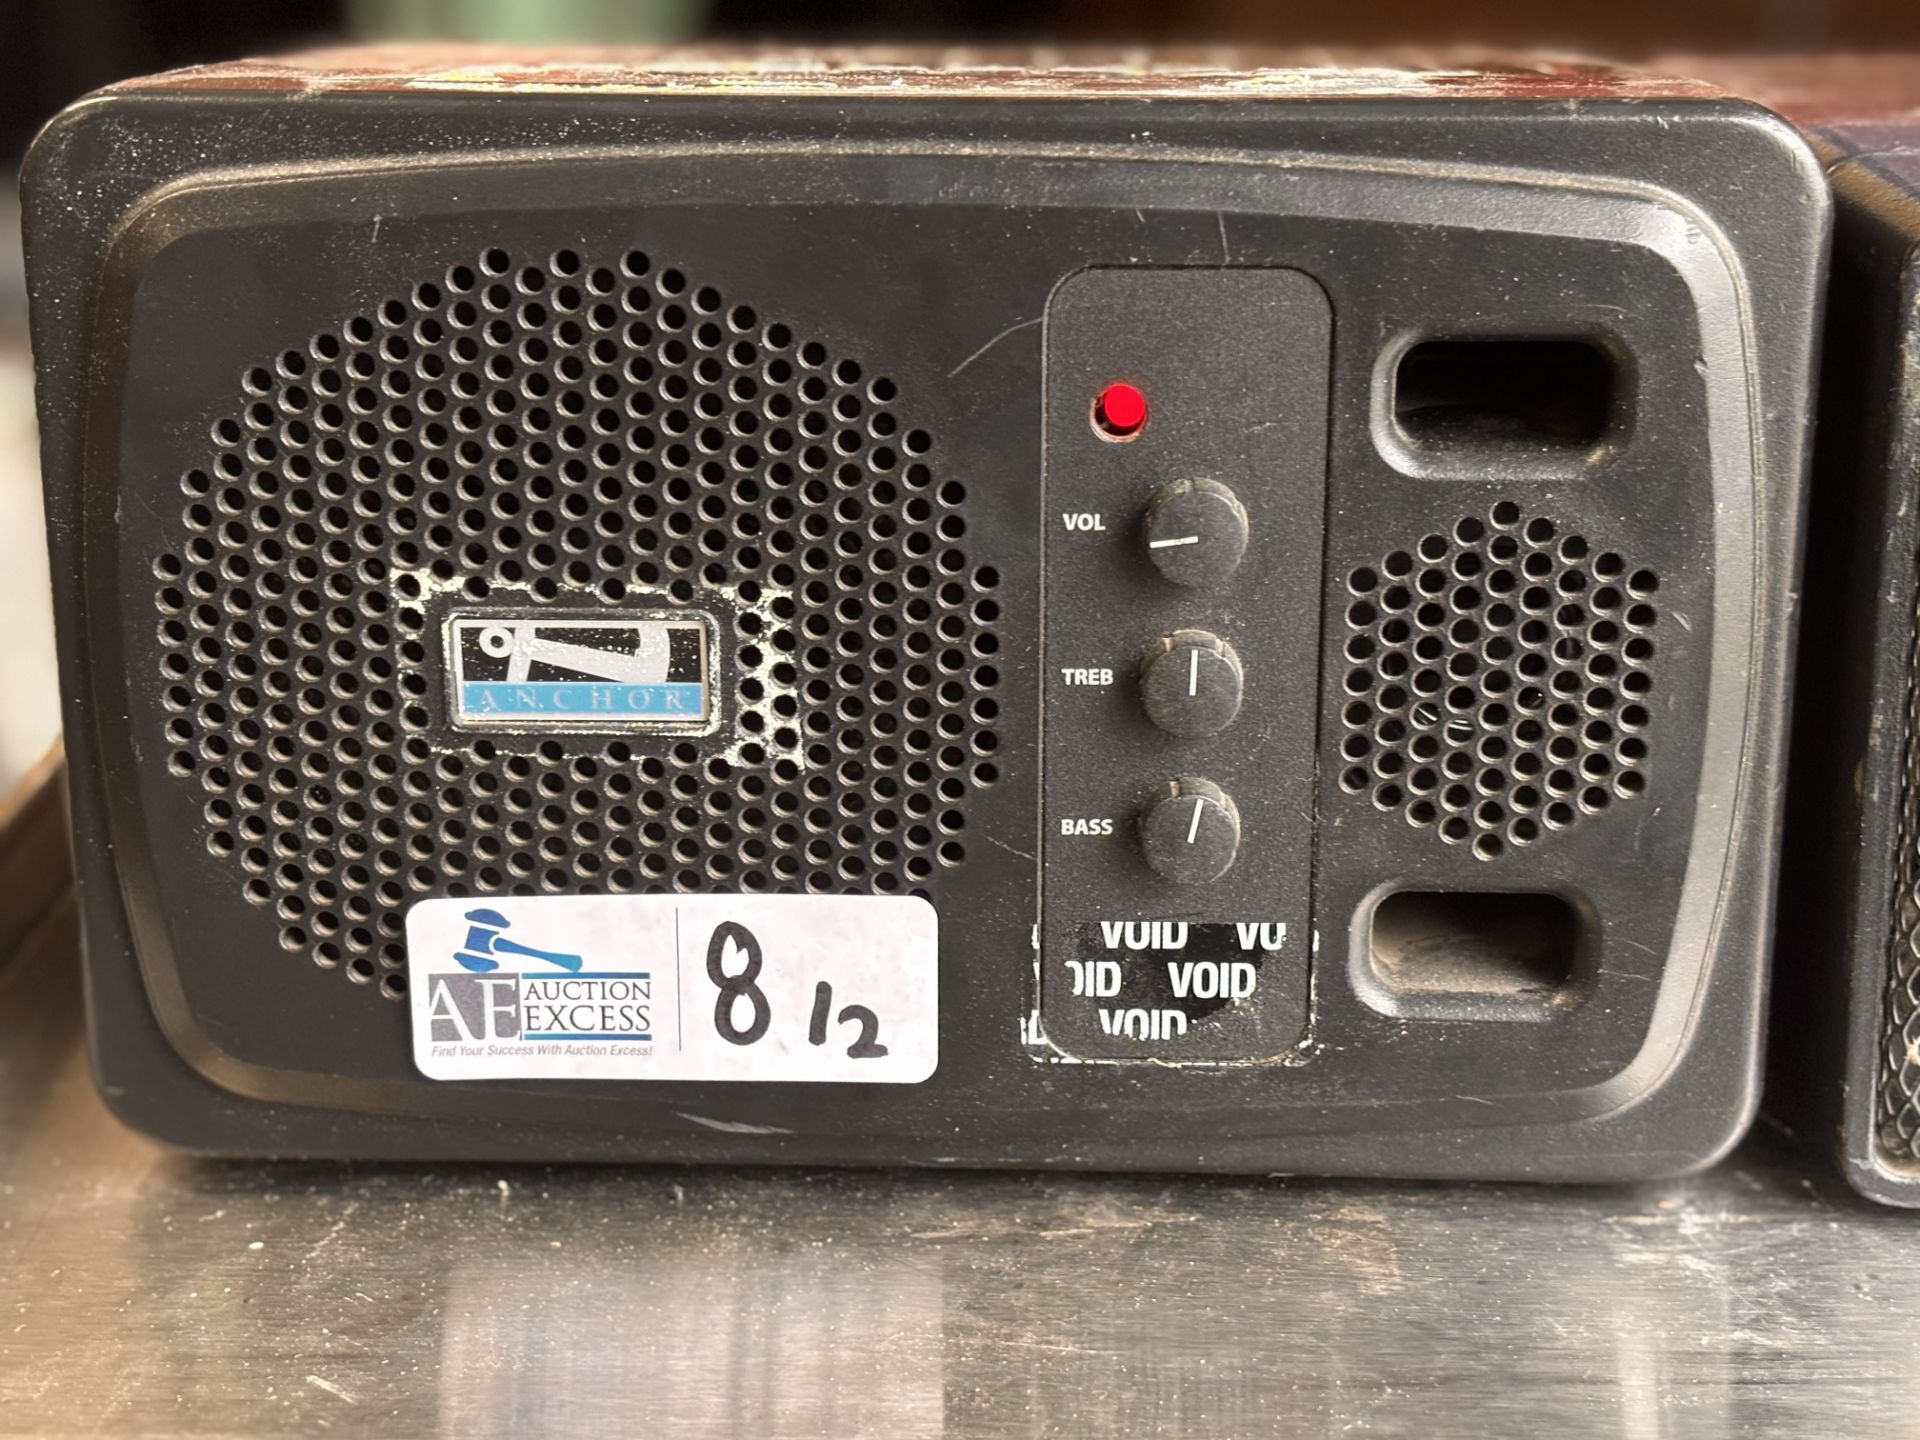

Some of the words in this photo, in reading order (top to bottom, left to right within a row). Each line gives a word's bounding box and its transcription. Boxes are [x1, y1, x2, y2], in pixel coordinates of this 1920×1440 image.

[1062, 513, 1106, 531] VOL
[1061, 668, 1114, 686] TREB
[478, 689, 683, 711] ANCHOR
[1061, 818, 1113, 836] BASS
[1100, 921, 1188, 950] VOID
[524, 981, 652, 1001] AUCTION
[706, 920, 771, 1046] 8
[1167, 962, 1257, 999] VOID
[524, 1004, 651, 1032] EXCESS
[1098, 1008, 1188, 1041] VOID
[431, 1046, 456, 1056] Find
[459, 1046, 483, 1056] Your
[487, 1045, 534, 1055] Success
[537, 1045, 562, 1055] With
[564, 1045, 606, 1055] Auction
[609, 1045, 653, 1056] Excess!
